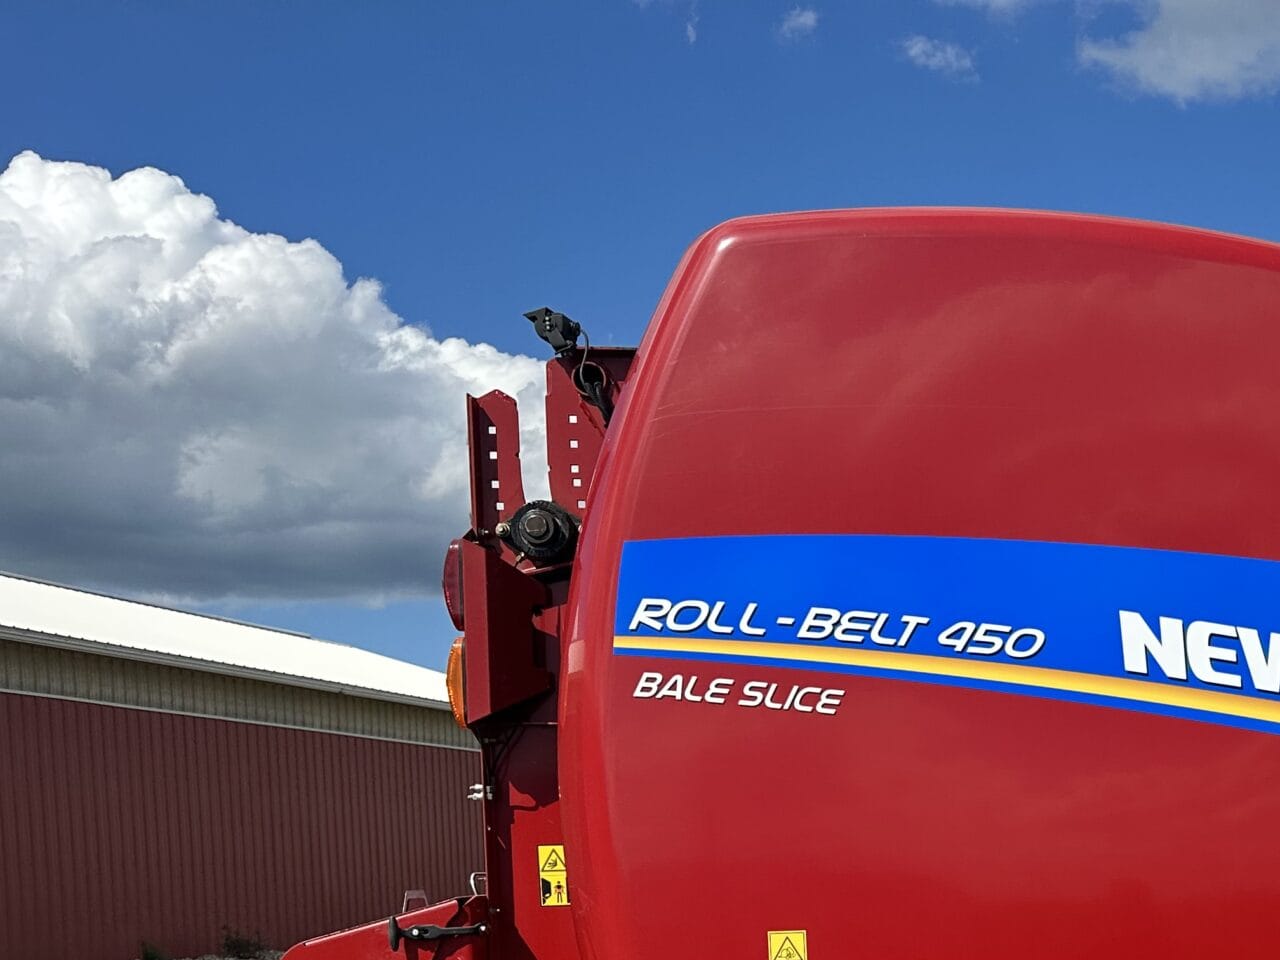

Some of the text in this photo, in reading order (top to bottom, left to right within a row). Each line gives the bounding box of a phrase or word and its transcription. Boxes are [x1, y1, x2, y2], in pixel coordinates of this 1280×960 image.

[937, 620, 1046, 659] 450
[633, 672, 846, 715] BALE SLICE
